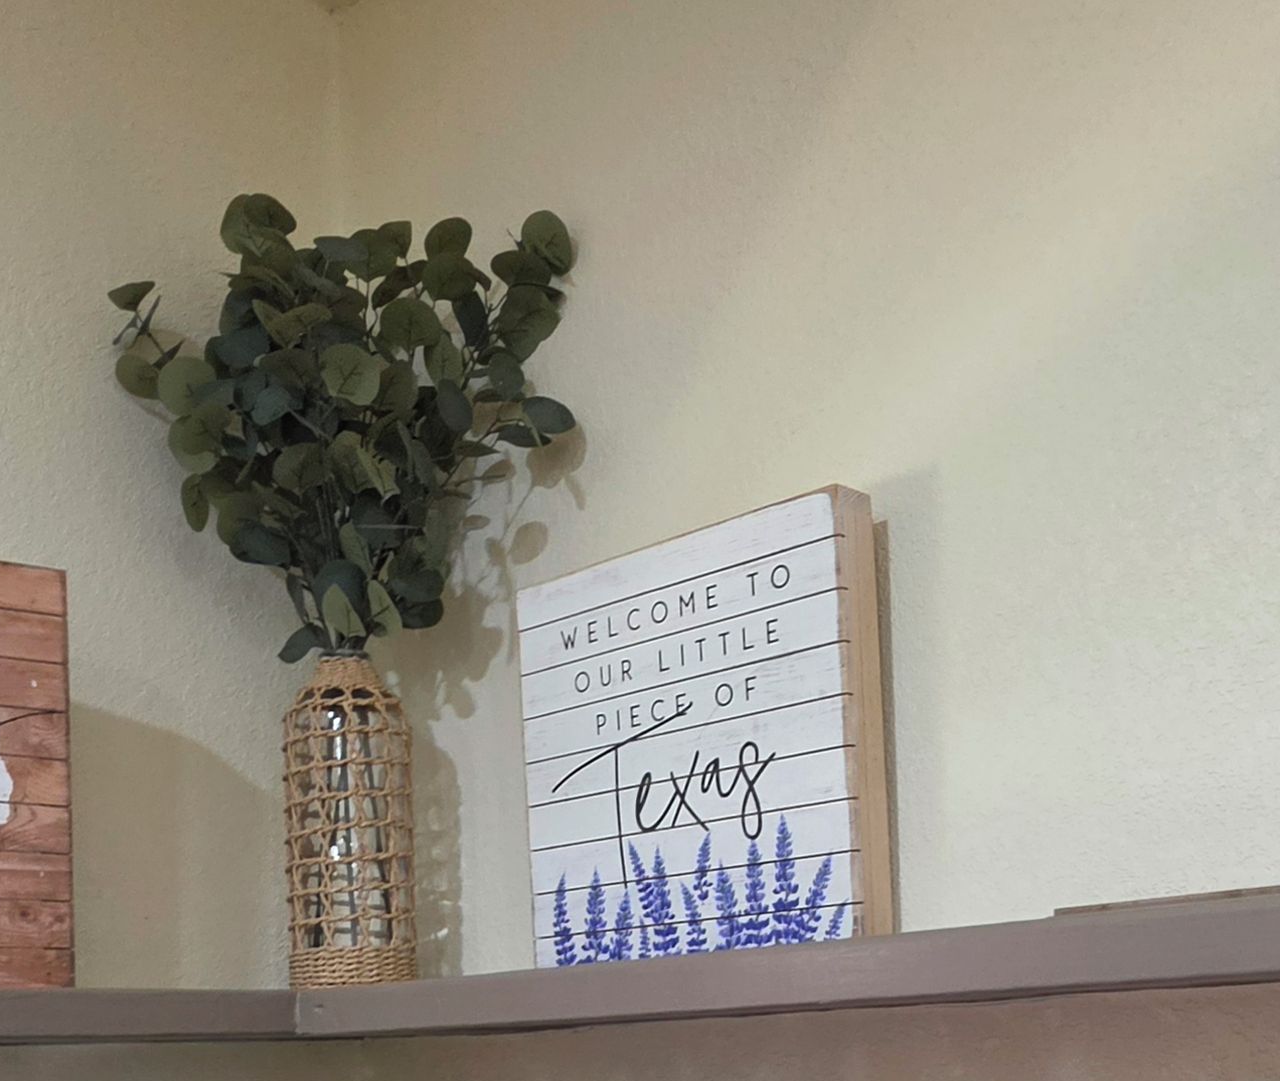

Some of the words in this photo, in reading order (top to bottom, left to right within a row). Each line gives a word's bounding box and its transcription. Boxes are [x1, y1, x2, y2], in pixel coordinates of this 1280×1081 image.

[560, 584, 718, 651] WELCOME
[746, 564, 791, 598] TO
[574, 659, 634, 694] OUR
[658, 618, 781, 672] LITTLE
[596, 693, 689, 735] PIECE
[715, 676, 758, 707] OF
[552, 701, 777, 889] Texas
